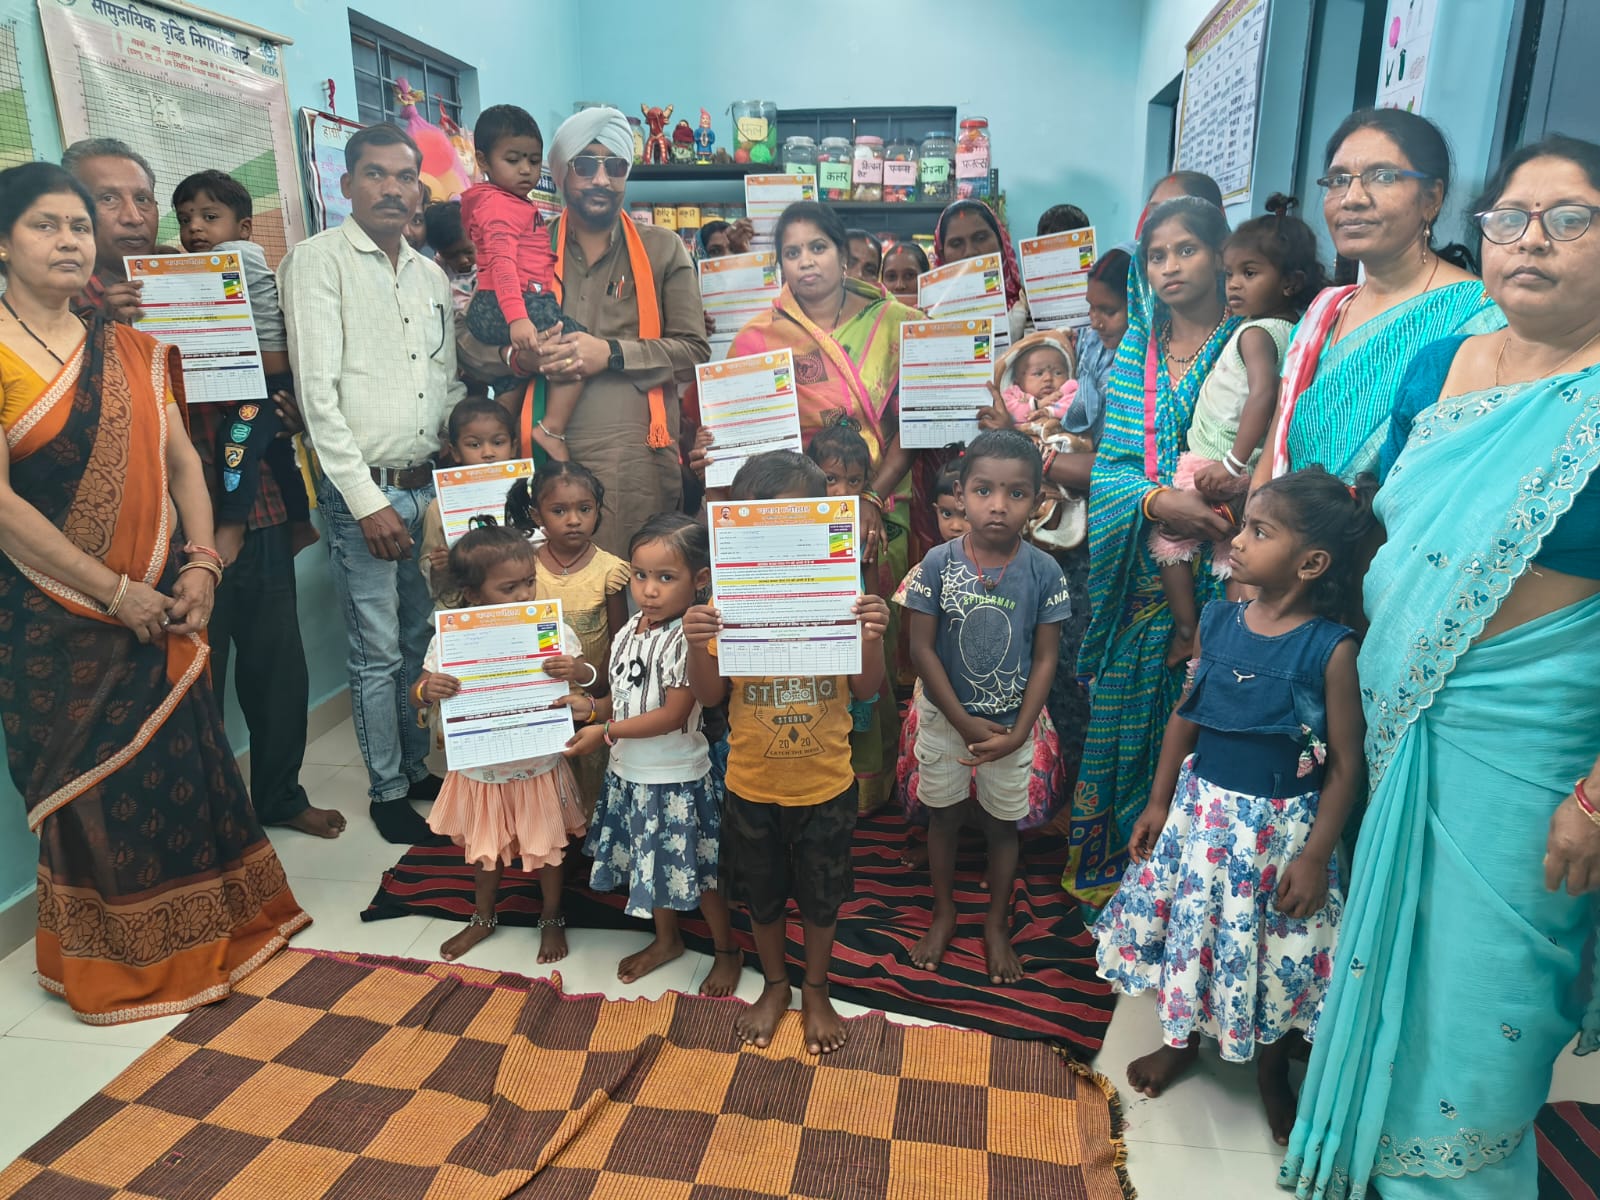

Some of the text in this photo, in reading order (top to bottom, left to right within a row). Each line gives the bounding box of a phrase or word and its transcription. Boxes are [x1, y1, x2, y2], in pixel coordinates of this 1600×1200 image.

[160, 19, 187, 45] वृद्धि
[231, 46, 250, 65] चार्ट
[261, 65, 279, 78] ICDS
[826, 171, 848, 183] कलर
[909, 580, 932, 598] ZING
[963, 595, 1016, 610] SPIDERMAN
[1045, 590, 1070, 607] AMA
[779, 737, 811, 749] 20 20
